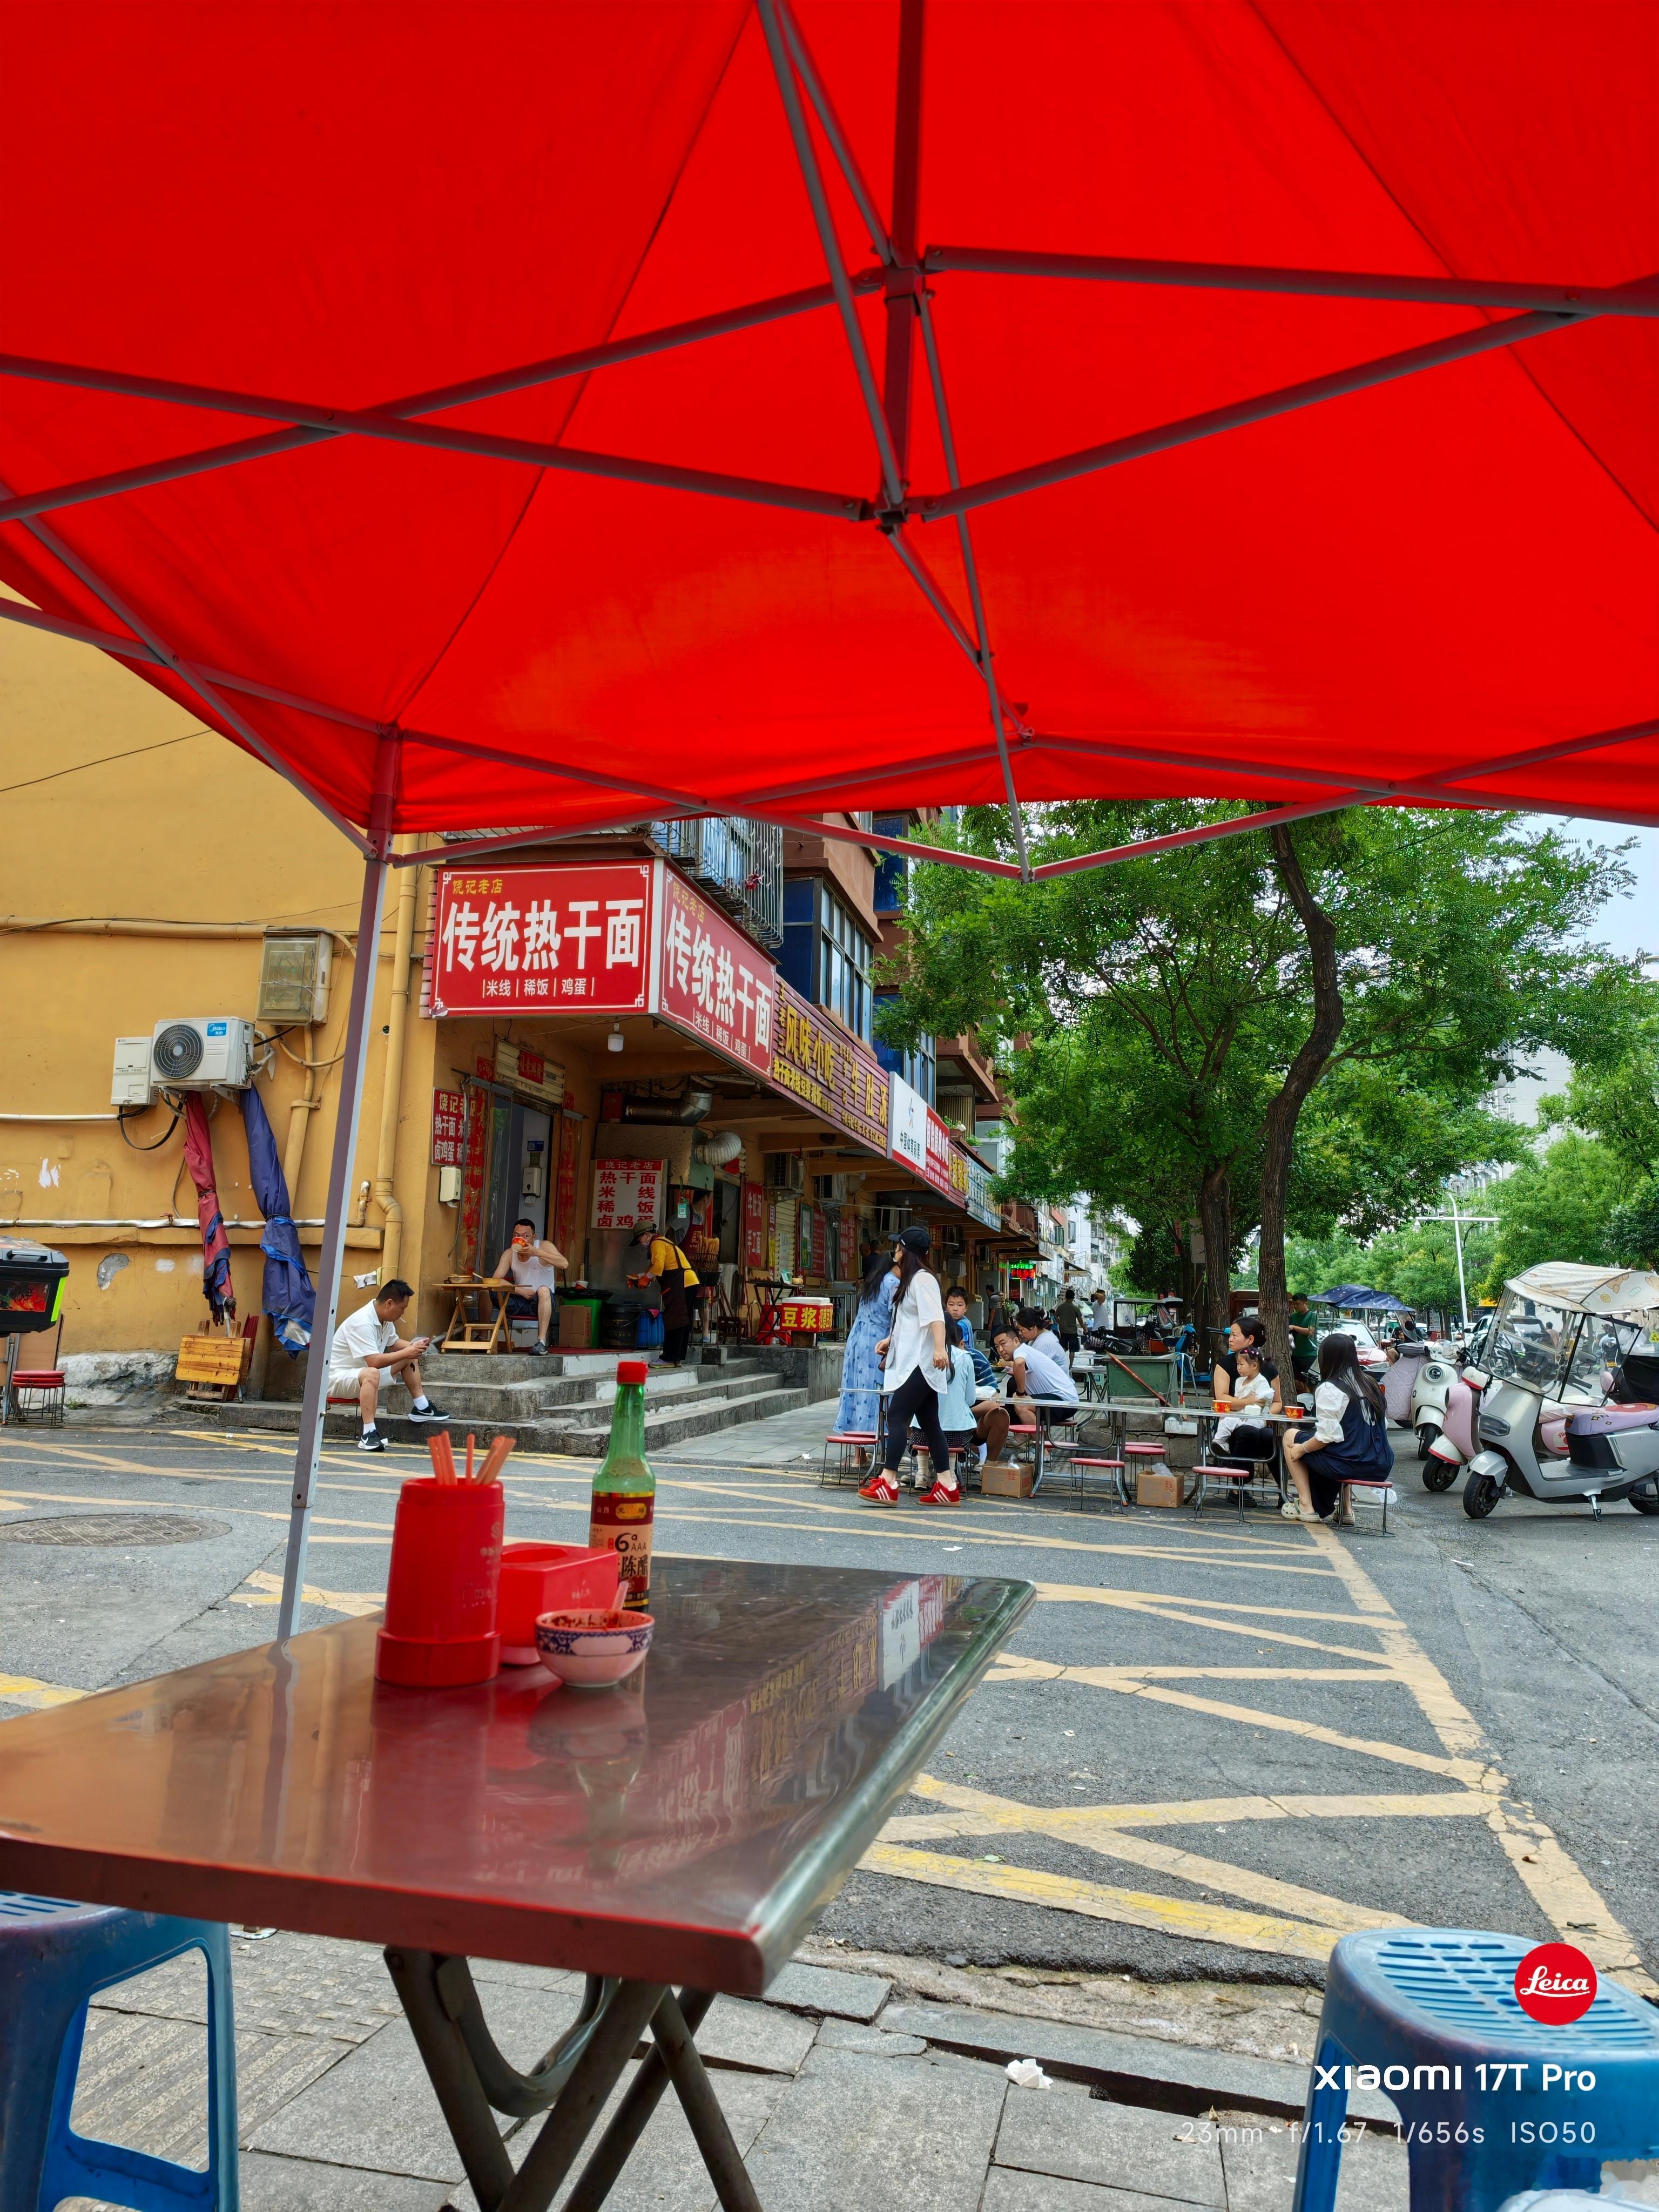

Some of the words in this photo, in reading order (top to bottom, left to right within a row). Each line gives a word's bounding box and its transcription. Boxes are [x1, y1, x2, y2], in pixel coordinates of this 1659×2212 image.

[453, 878, 503, 895] 饶记老店
[673, 882, 705, 923] 饶记老店
[442, 899, 644, 972] 传统热干面
[486, 981, 510, 997] 米线
[524, 979, 549, 996] 稀饭
[562, 977, 587, 995] 鸡蛋
[667, 903, 772, 1054] 传统热干面
[695, 1011, 709, 1034] 米线
[717, 1025, 729, 1047] 稀饭
[734, 1038, 746, 1058] 鸡蛋
[785, 1004, 837, 1092] 风味小吃
[851, 1061, 888, 1127] 牛肚汤
[435, 1114, 456, 1137] 热干面
[435, 1138, 455, 1162] 卤鸡蛋
[599, 1171, 657, 1184] 热干面
[604, 1161, 654, 1170] 饶记老店
[782, 1307, 817, 1329] 豆浆
[631, 1542, 647, 1552] AAA
[618, 1554, 649, 1578] 陈醋
